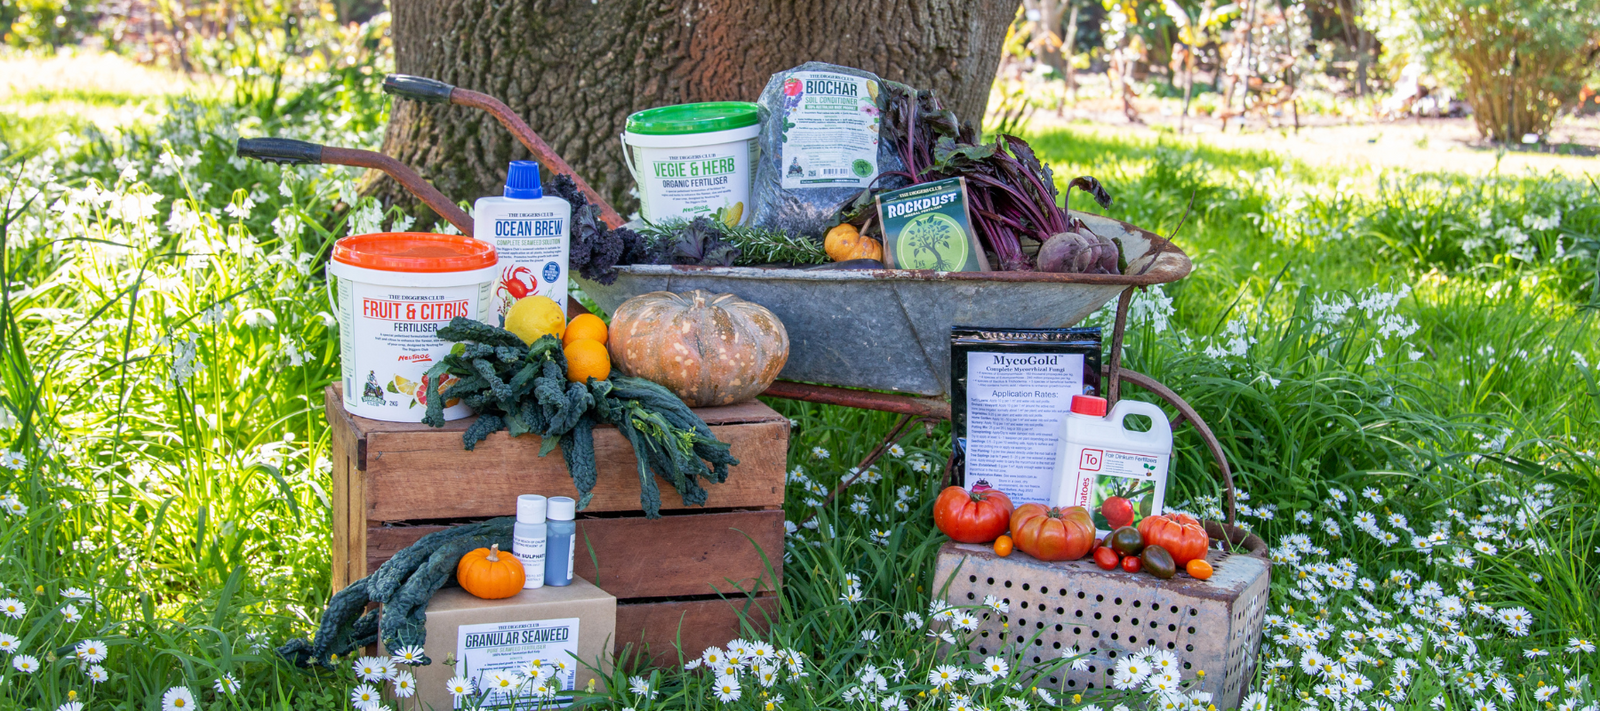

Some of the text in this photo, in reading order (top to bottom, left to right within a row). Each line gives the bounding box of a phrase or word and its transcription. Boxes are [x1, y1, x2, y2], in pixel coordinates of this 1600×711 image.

[806, 80, 857, 96] BIOCHAR
[653, 158, 735, 177] VEGIE & HERB
[663, 176, 728, 188] ORGANIC FERTILISER
[888, 192, 957, 218] ROCKDUST
[495, 220, 563, 236] OCEAN BREW
[363, 299, 469, 320] FRUIT & CITRUS
[394, 323, 438, 332] FERTILISER
[992, 390, 1032, 398] Application
[1085, 454, 1098, 465] To
[1080, 478, 1090, 506] matoes
[465, 628, 569, 648] GRANULAR SEAWEED
